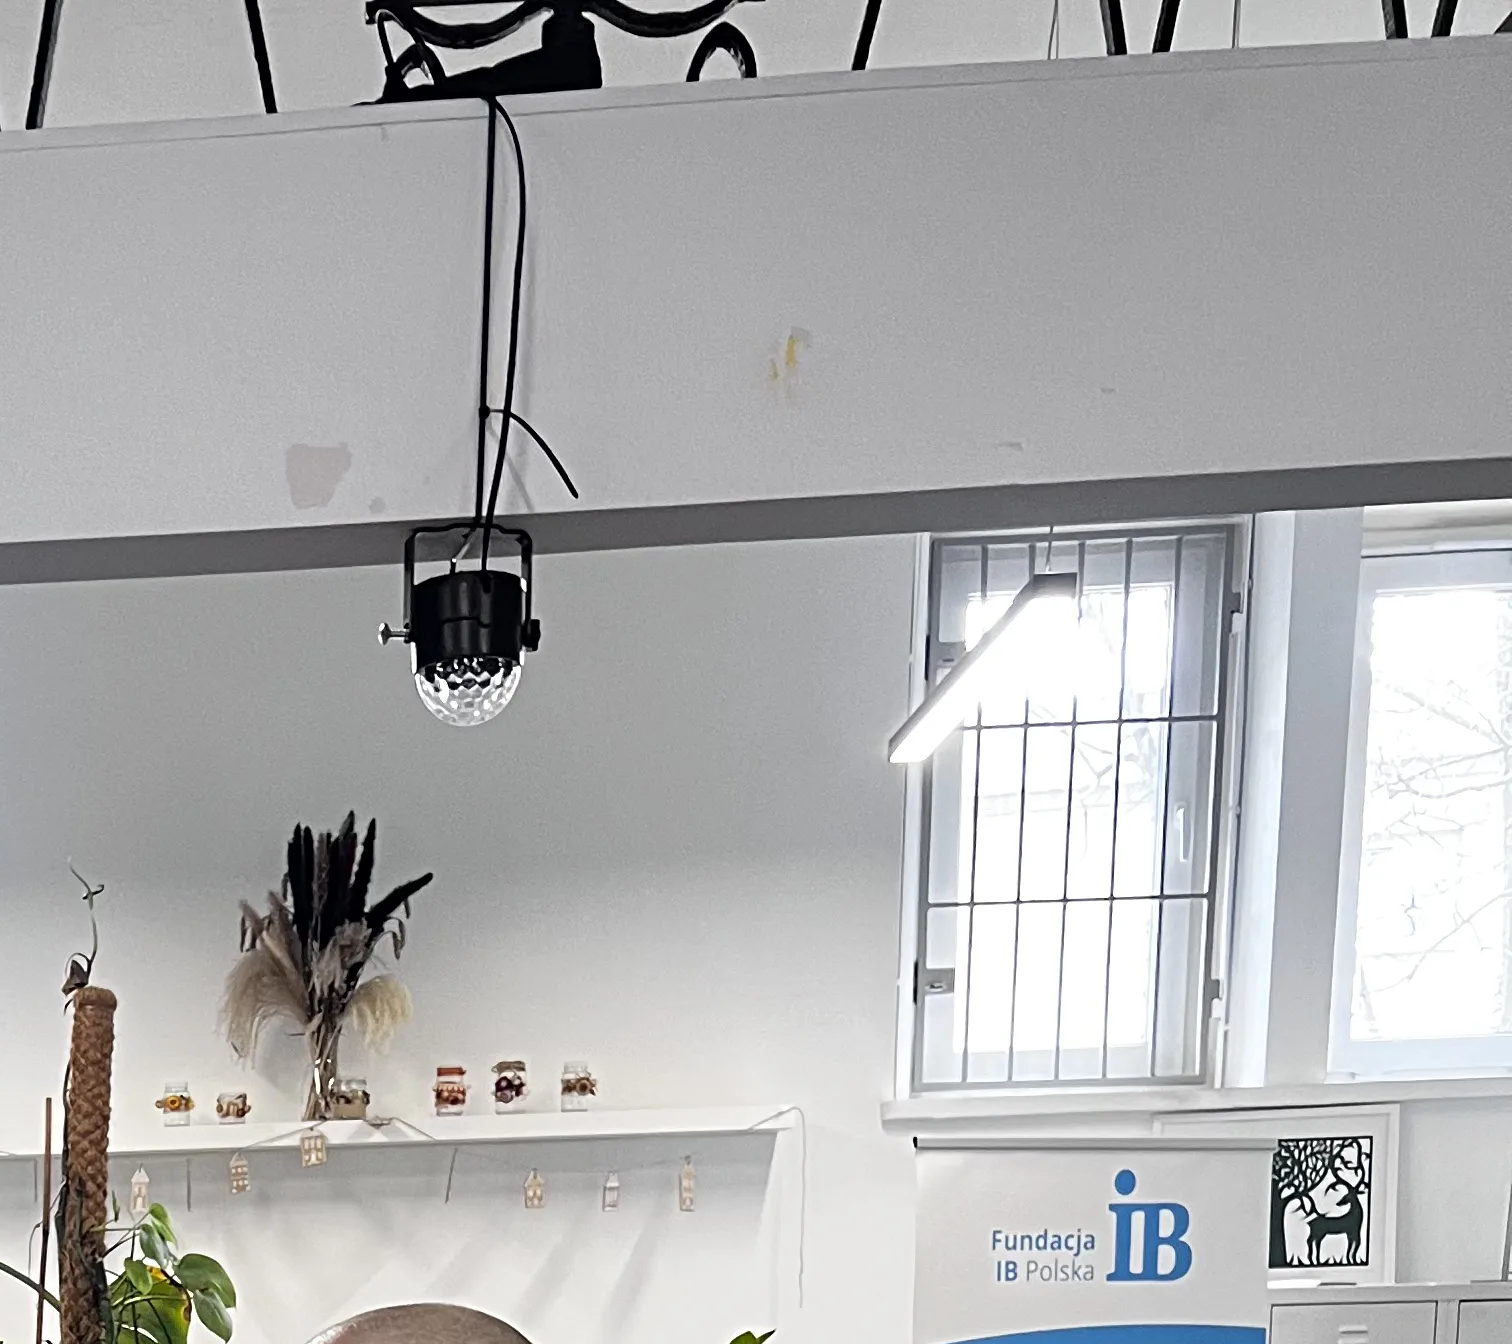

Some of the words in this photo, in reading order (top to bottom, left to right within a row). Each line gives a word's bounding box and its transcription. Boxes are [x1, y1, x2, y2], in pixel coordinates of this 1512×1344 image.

[992, 1229, 1096, 1257] Fundacja
[996, 1260, 1018, 1282] IB
[1026, 1258, 1095, 1282] Polska
